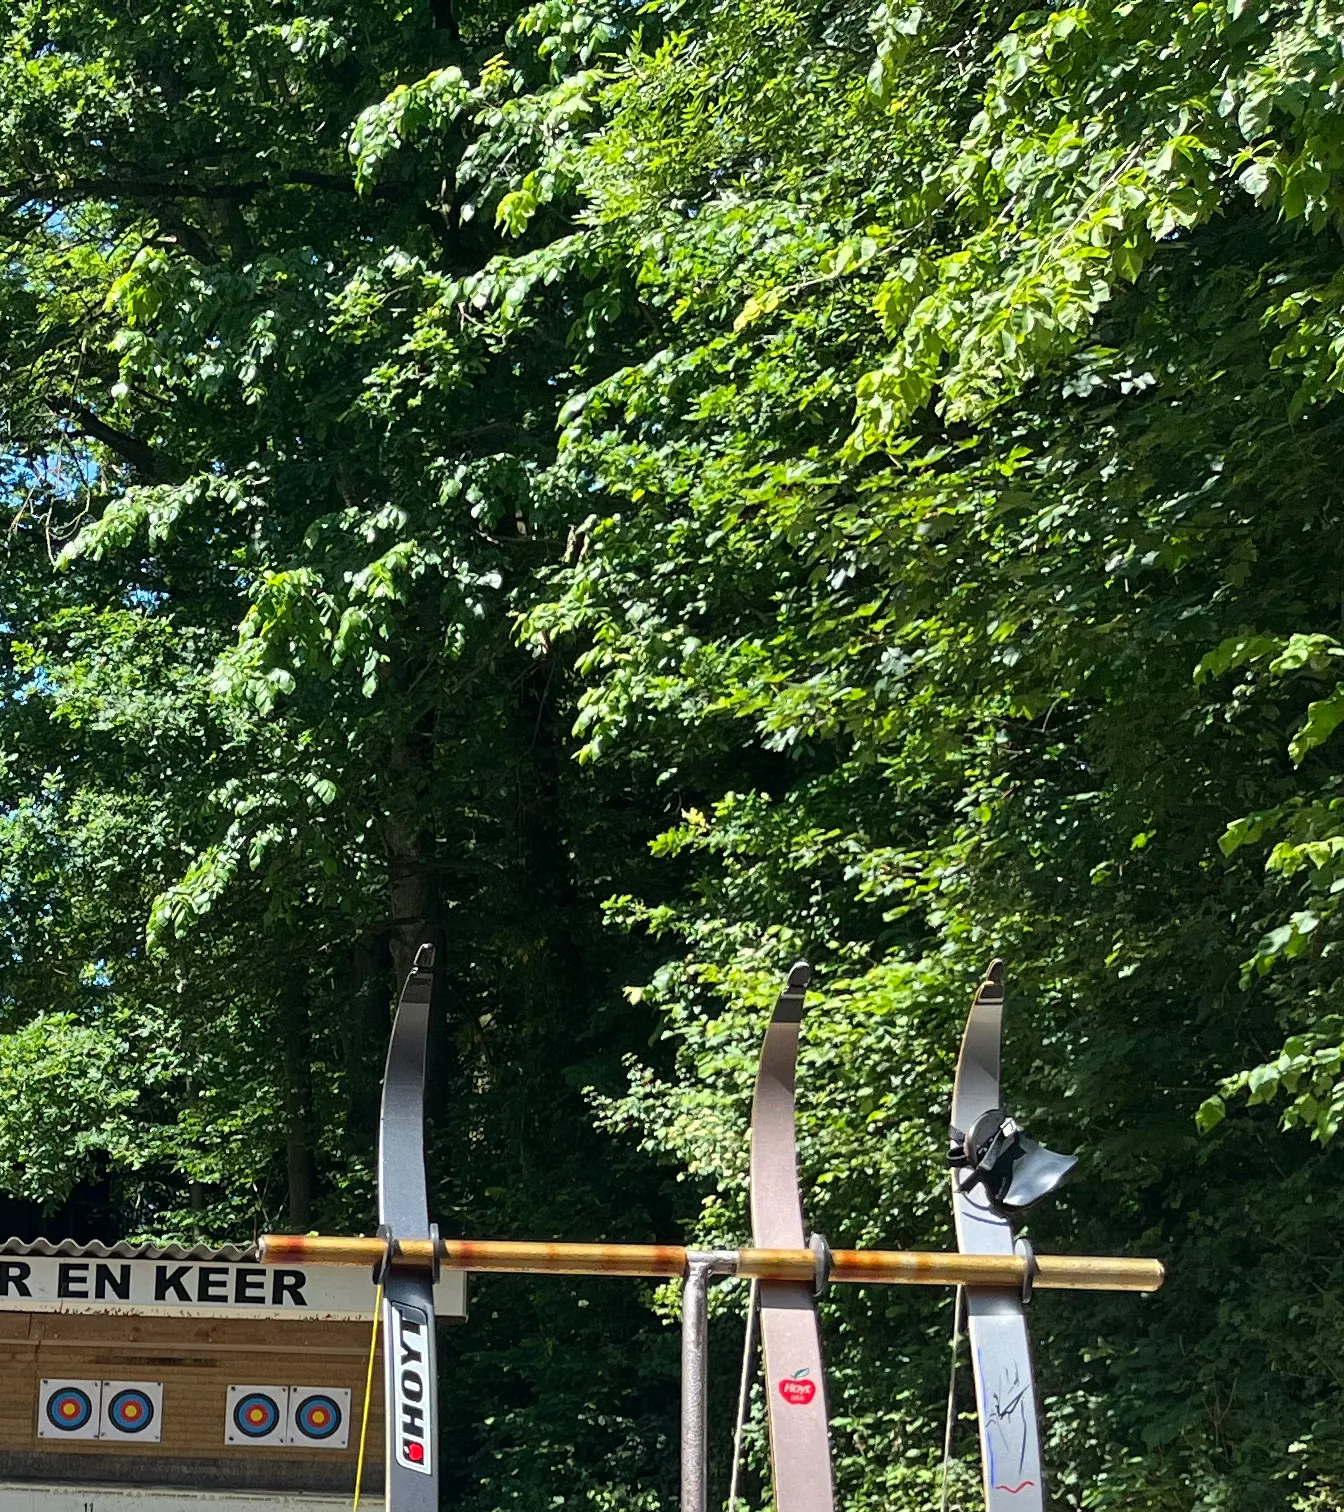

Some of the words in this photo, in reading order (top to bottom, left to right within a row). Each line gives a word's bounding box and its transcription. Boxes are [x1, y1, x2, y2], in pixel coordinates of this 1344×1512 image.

[59, 1262, 132, 1302] EN
[155, 1265, 308, 1307] KEER
[399, 1309, 424, 1439] HOYT
